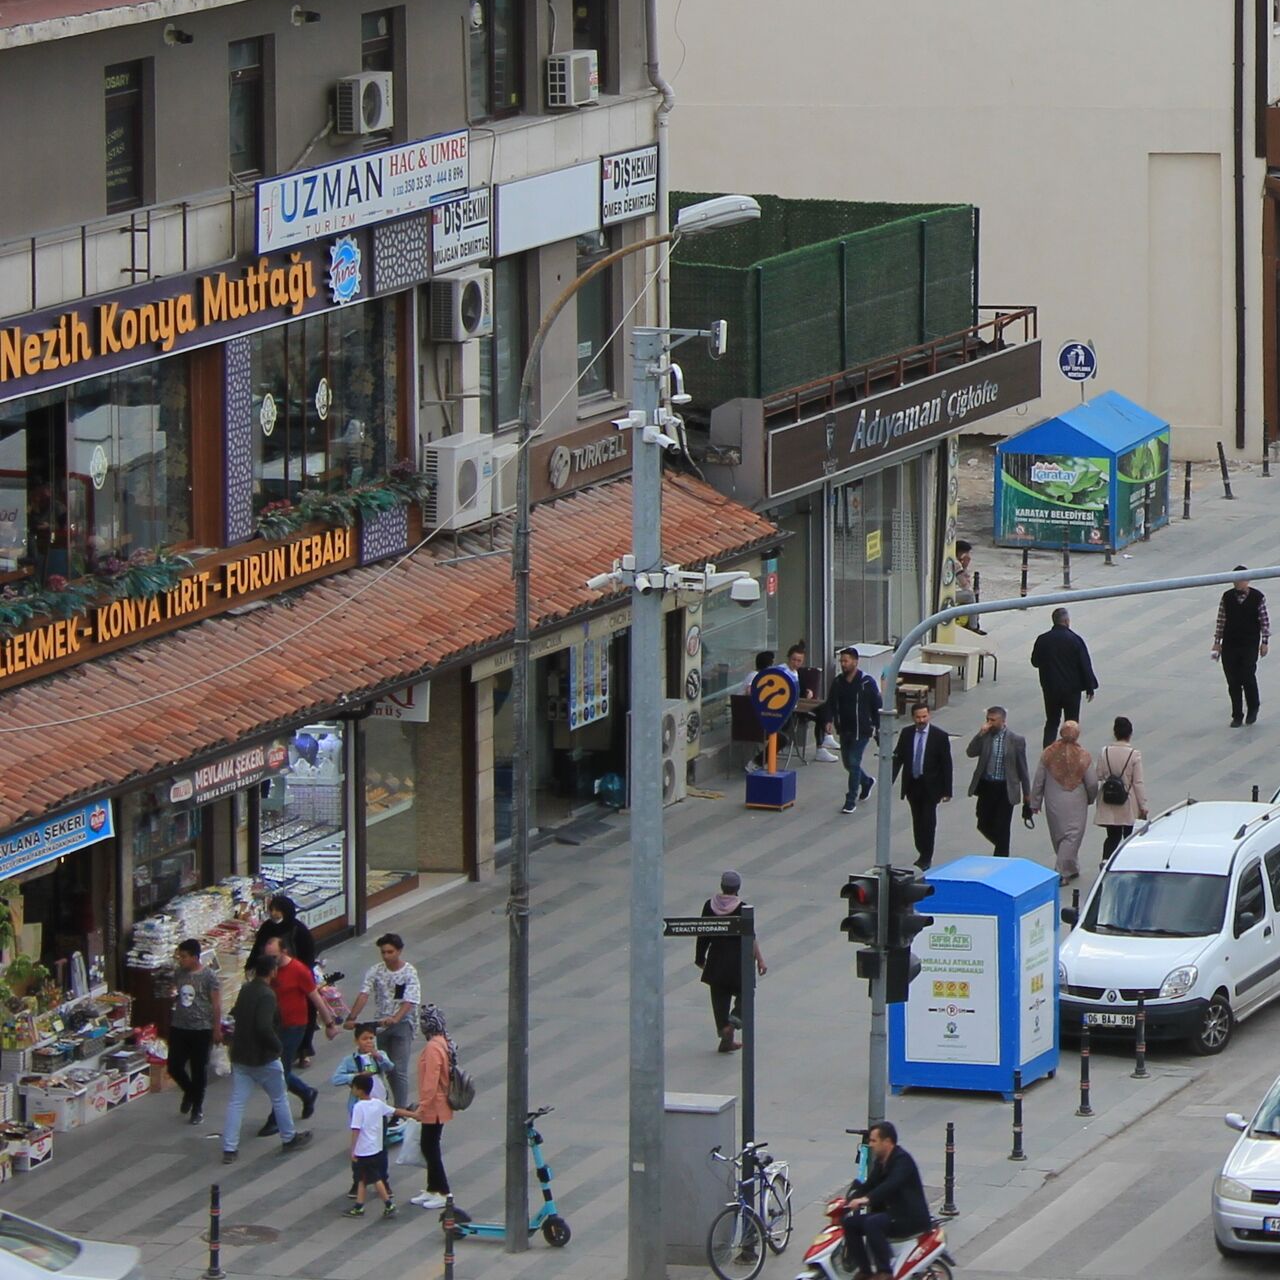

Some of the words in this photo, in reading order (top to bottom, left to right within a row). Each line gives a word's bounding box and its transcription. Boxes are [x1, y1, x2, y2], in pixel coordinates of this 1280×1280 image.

[389, 150, 415, 176] HAC
[418, 147, 428, 168] &
[431, 136, 467, 165] UMRE
[280, 157, 384, 223] UZMAN
[0, 311, 92, 382] Nezih
[100, 293, 197, 356] Konya
[203, 252, 317, 326] Mutfağı
[850, 397, 943, 454] Adıyaman
[947, 379, 999, 423] Çiğköfte
[572, 433, 628, 473] TURKCELL
[1015, 508, 1049, 519] KARATAY
[1050, 510, 1095, 521] BELEDİYESİ
[97, 593, 161, 643] KONYA
[226, 546, 286, 599] FURUN
[195, 759, 235, 790] MEVLANA
